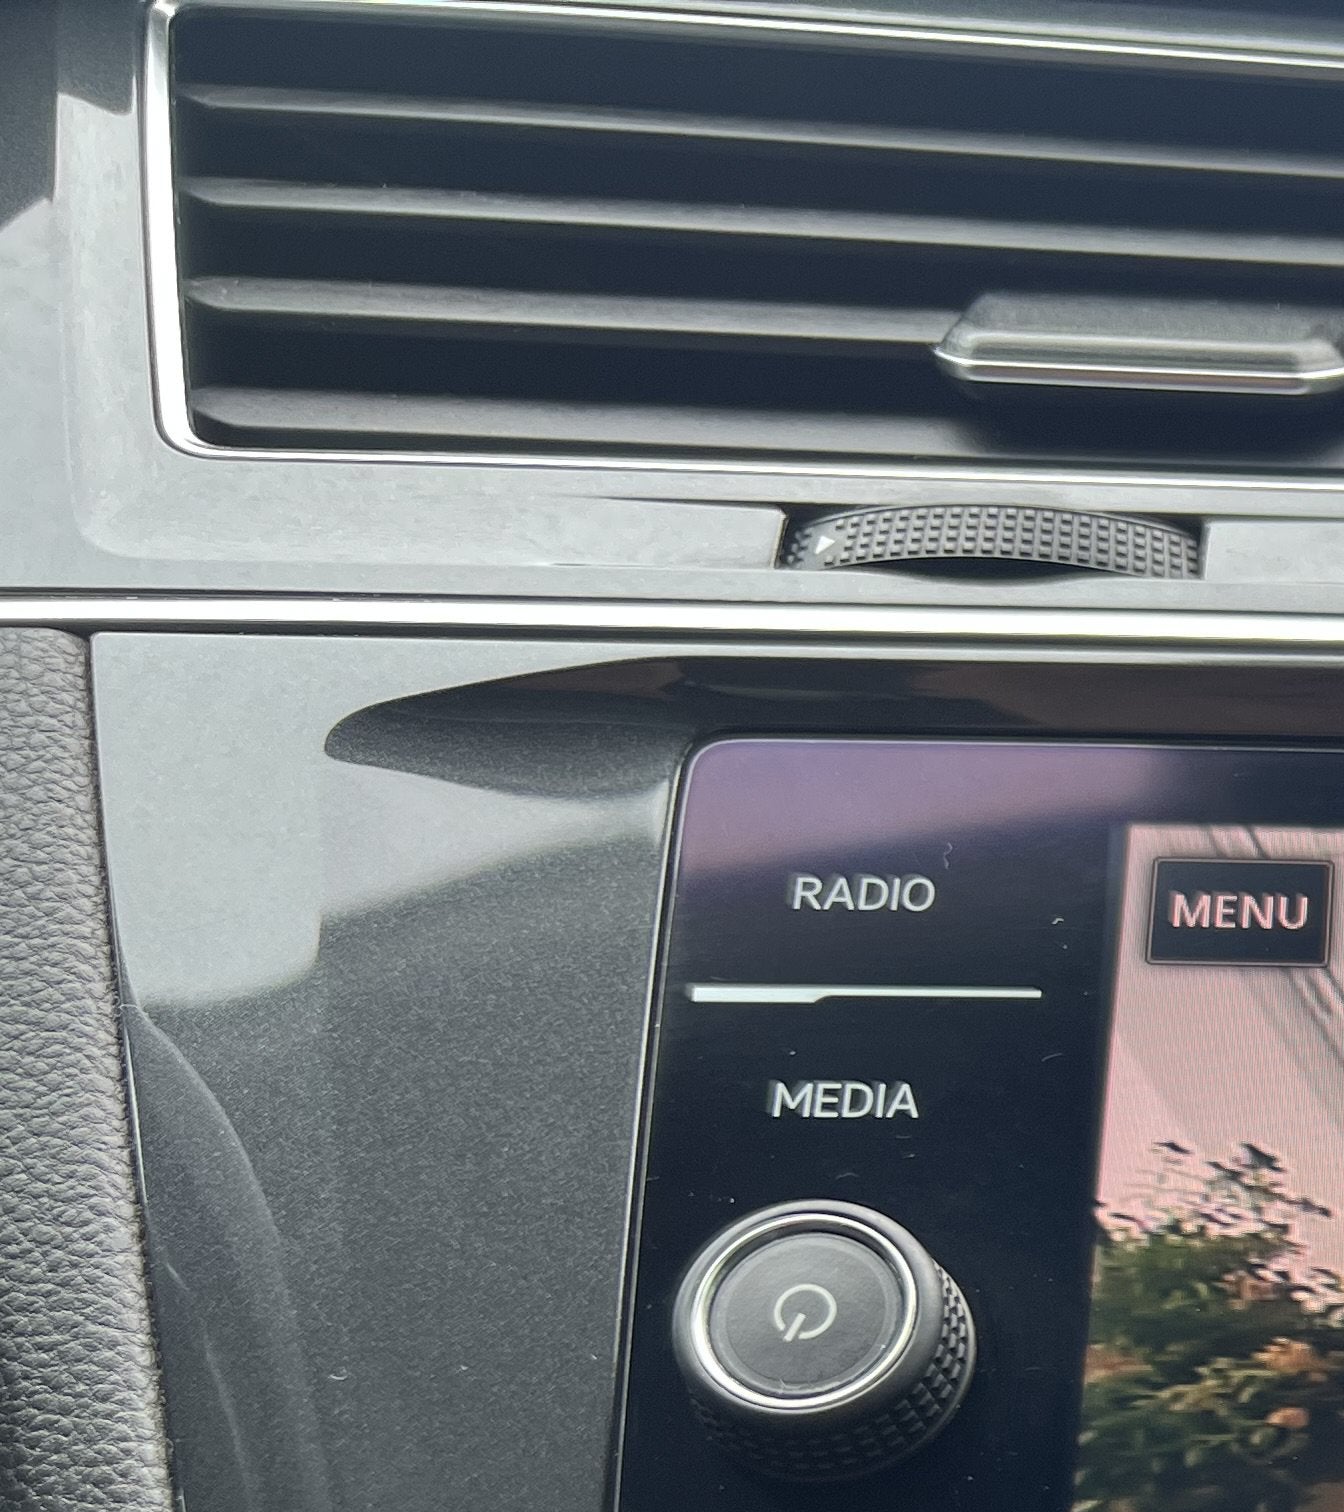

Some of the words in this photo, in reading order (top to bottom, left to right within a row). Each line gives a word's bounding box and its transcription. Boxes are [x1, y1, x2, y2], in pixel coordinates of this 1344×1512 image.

[791, 875, 937, 912] RADIO
[1171, 893, 1309, 931] MENU
[769, 1081, 920, 1120] MEDIA
